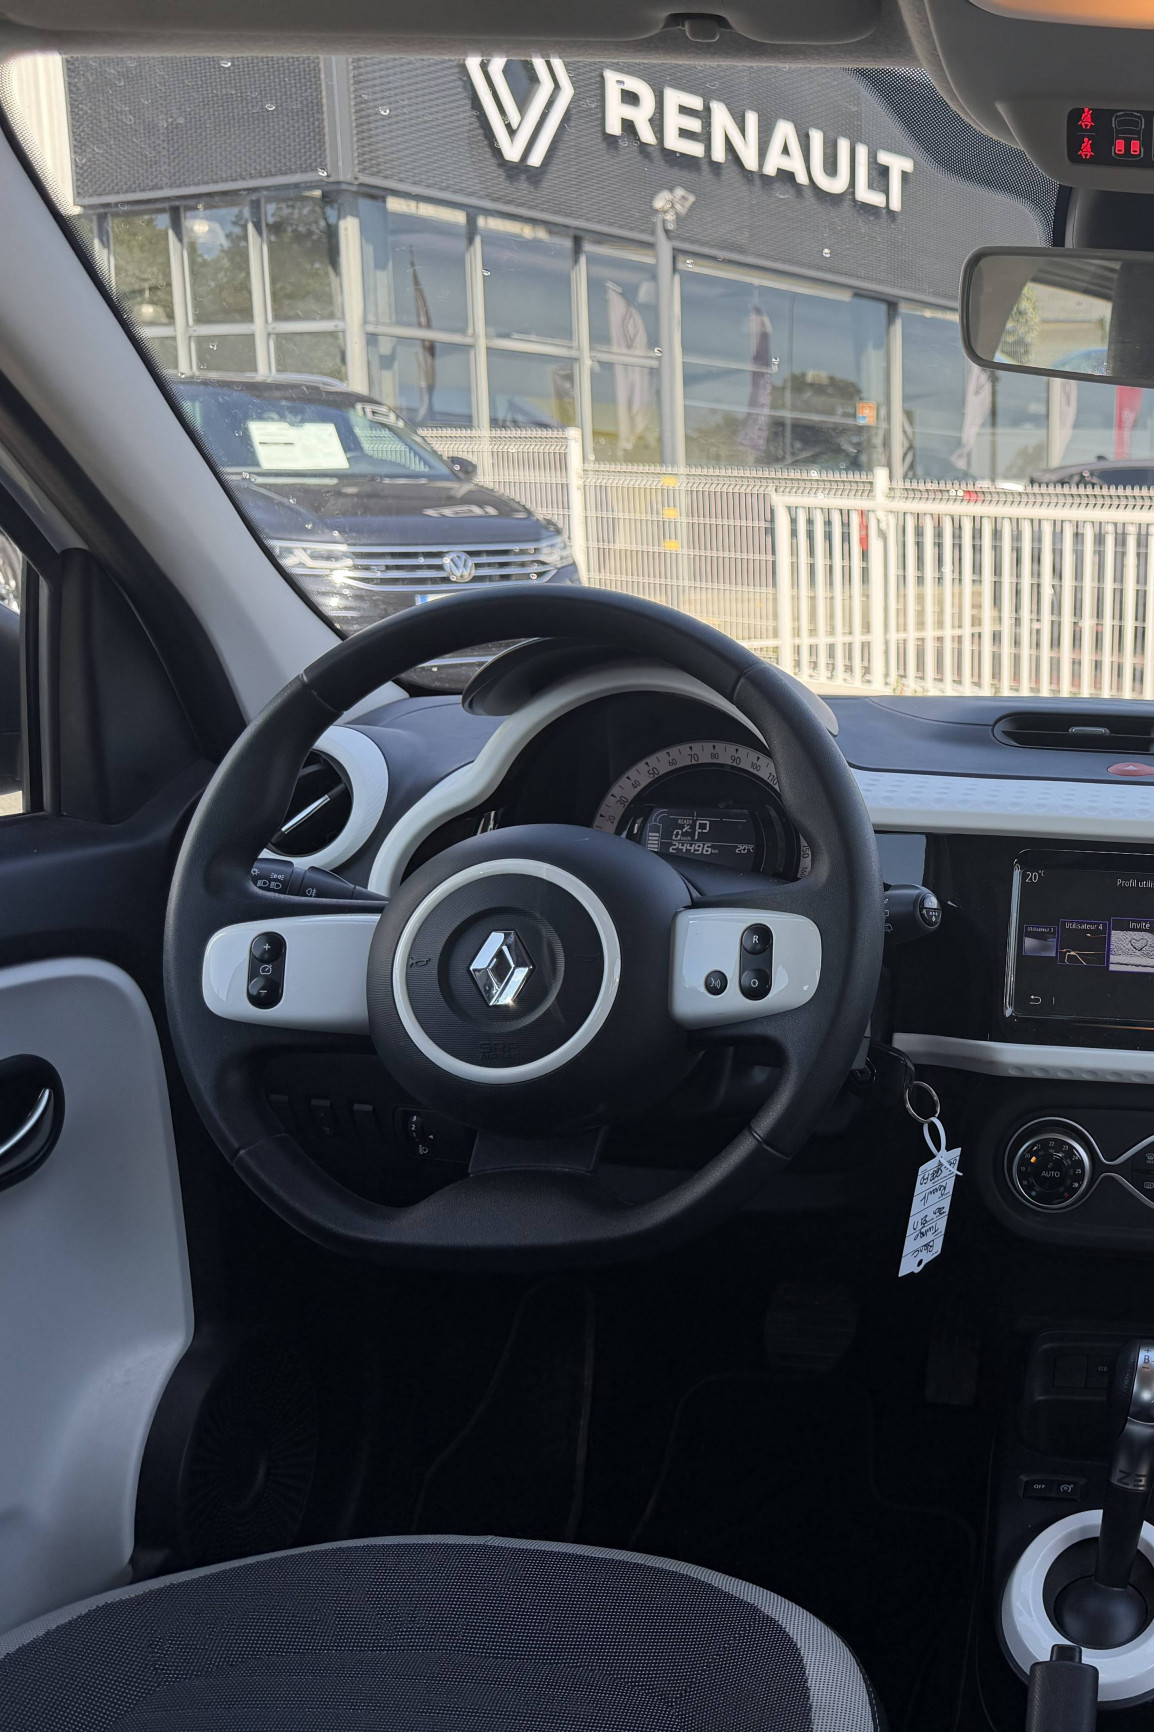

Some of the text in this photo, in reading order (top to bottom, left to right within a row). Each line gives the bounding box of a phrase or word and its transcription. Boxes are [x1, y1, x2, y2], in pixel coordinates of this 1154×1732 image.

[603, 68, 914, 213] RENAULT
[688, 753, 699, 763] 70
[710, 752, 719, 760] 80
[730, 755, 742, 766] 90
[668, 758, 677, 767] 60
[750, 761, 761, 772] 100
[647, 766, 660, 779] 50
[631, 779, 641, 790] 40
[766, 772, 779, 786] 110
[616, 795, 629, 808] 30
[607, 815, 616, 825] 20
[694, 820, 710, 840] P
[669, 841, 712, 855] 24496
[801, 845, 810, 859] 150
[1116, 879, 1137, 888] Profil
[1065, 922, 1097, 930] Utilisateur
[1129, 921, 1151, 929] Invité
[752, 935, 759, 943] R
[1143, 1355, 1150, 1364] B
